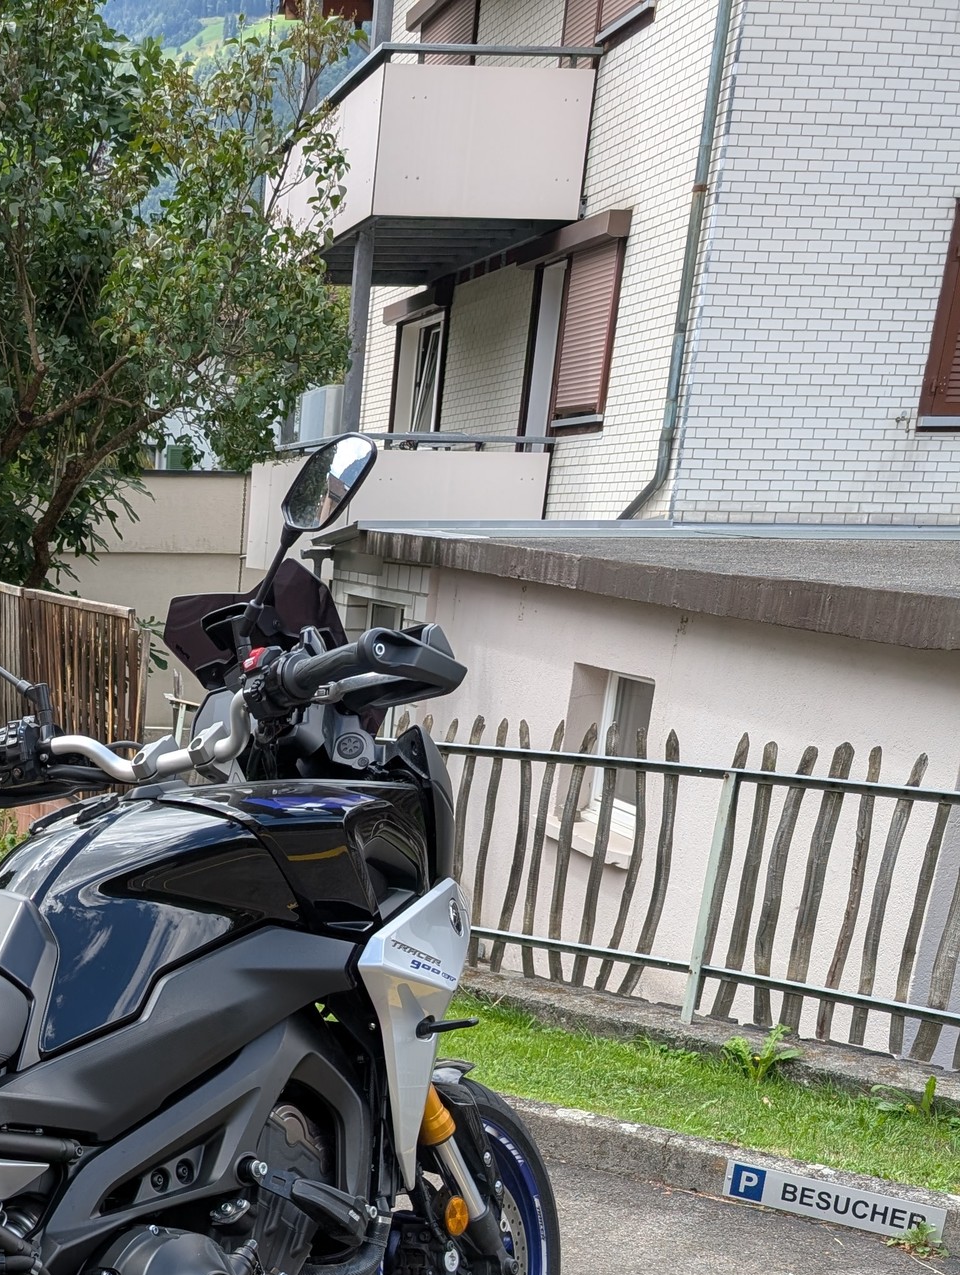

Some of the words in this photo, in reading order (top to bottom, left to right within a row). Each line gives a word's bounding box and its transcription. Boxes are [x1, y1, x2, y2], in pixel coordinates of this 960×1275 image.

[391, 939, 442, 967] TRACER
[410, 959, 441, 975] 900
[738, 1170, 759, 1194] P
[780, 1182, 927, 1231] BESUCHER
